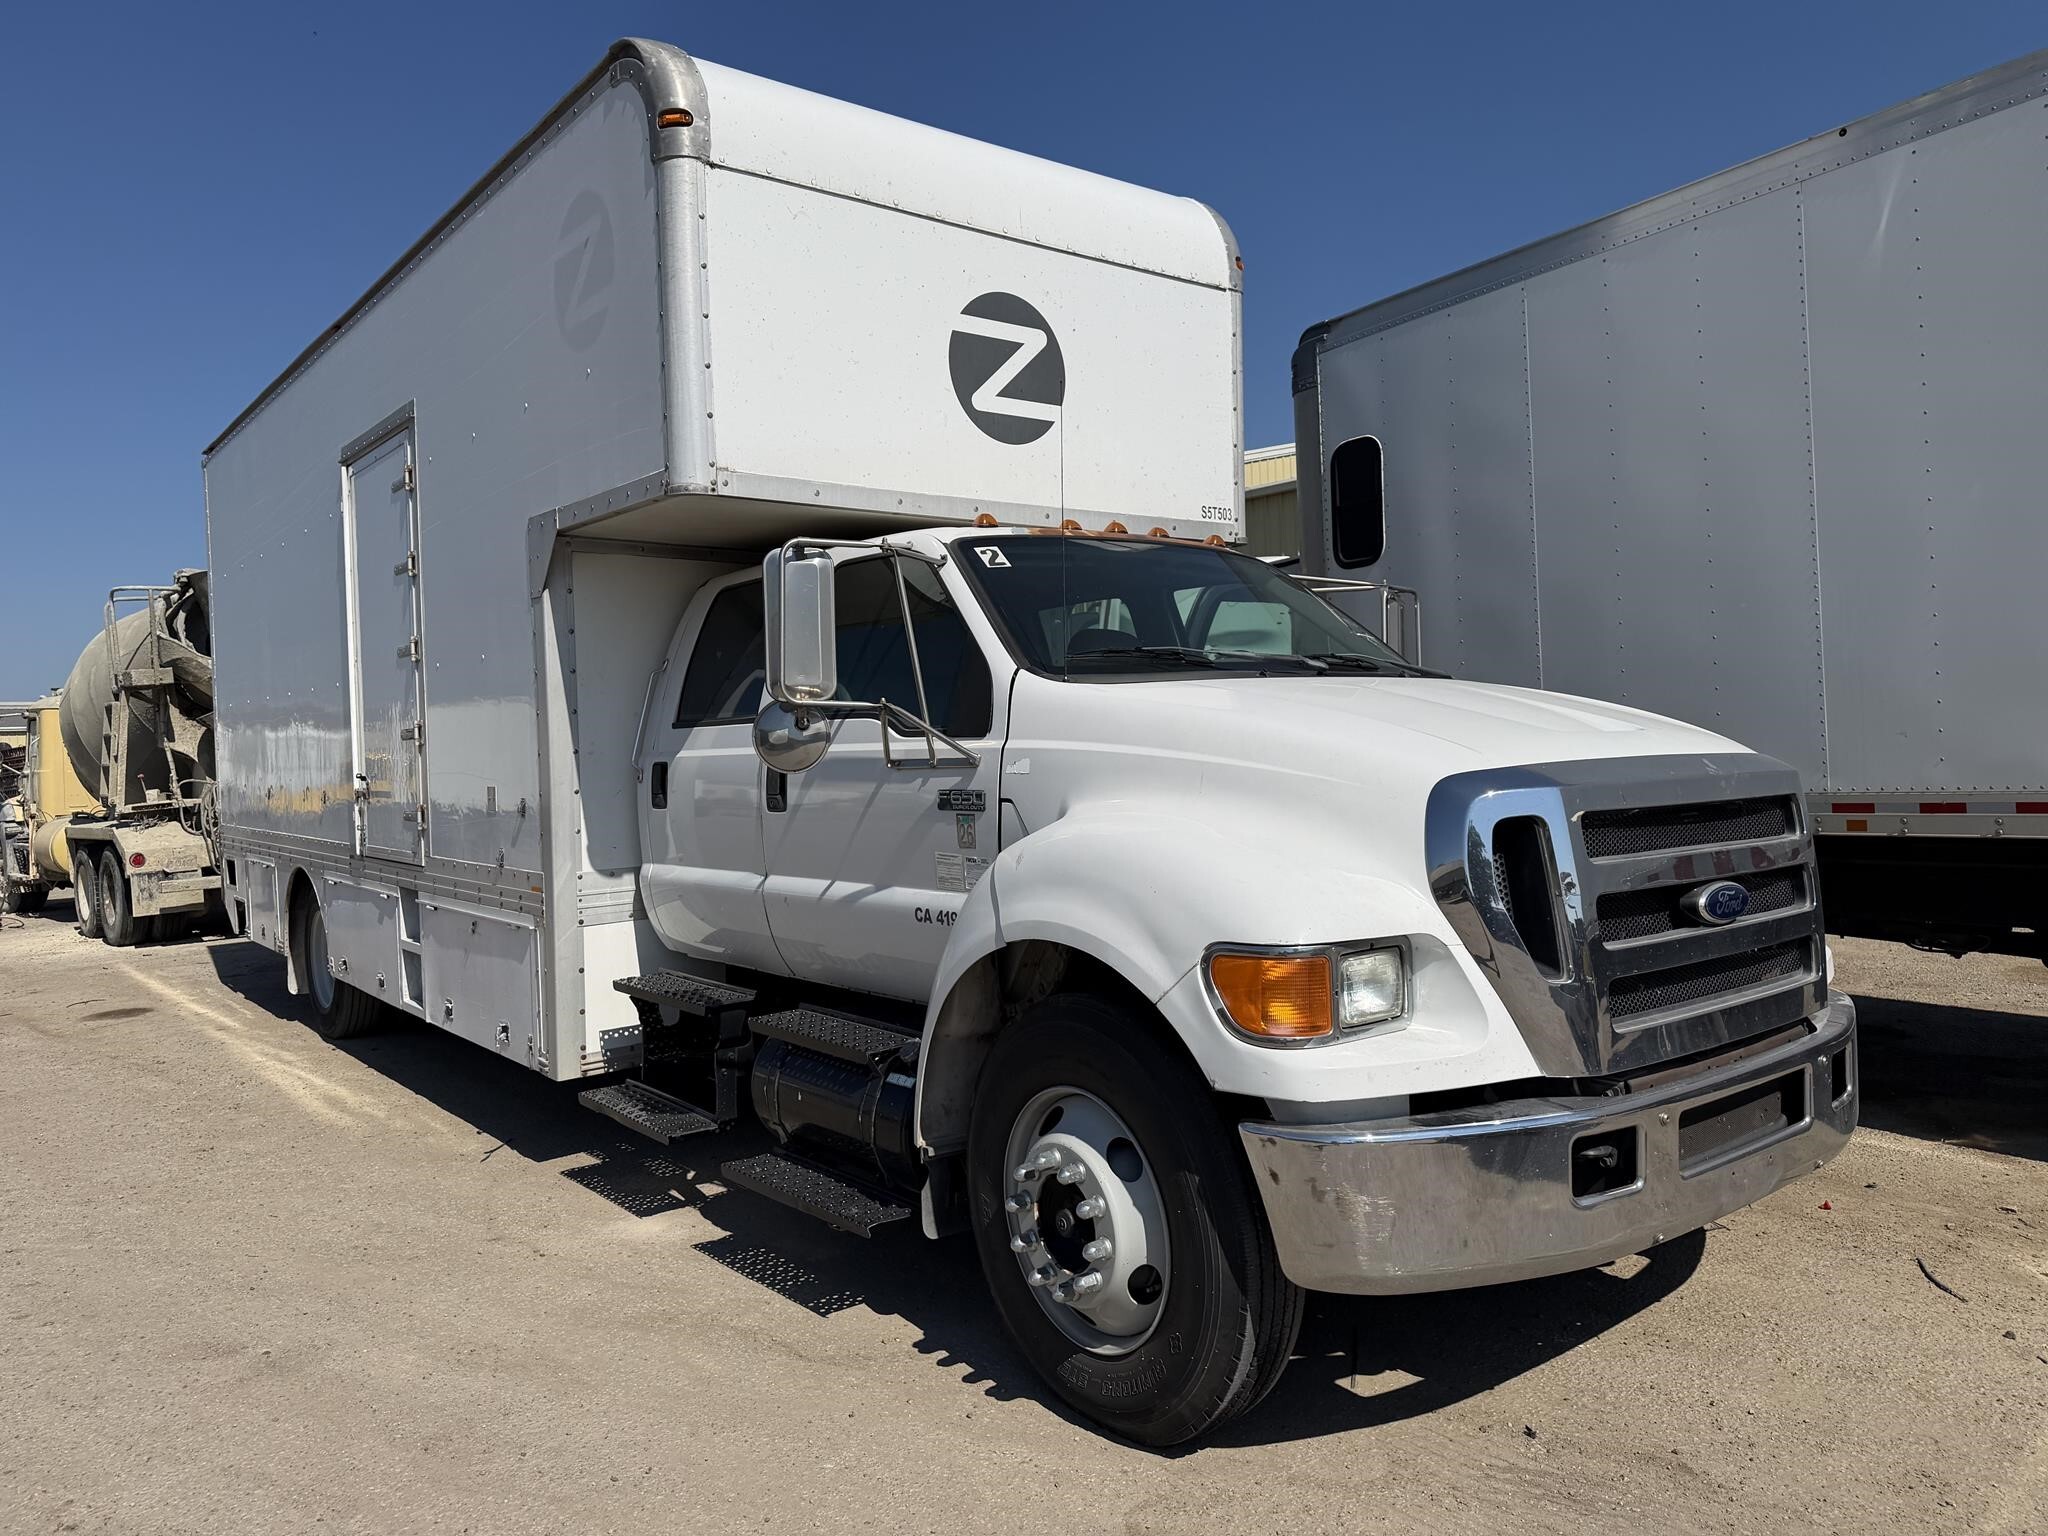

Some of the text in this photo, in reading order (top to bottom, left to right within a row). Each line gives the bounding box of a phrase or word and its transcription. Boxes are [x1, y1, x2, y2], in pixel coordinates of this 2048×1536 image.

[951, 313, 1062, 424] Z
[1201, 505, 1233, 521] S5T503
[980, 548, 1007, 567] 2
[1716, 890, 1743, 914] Ford
[914, 907, 933, 924] CA
